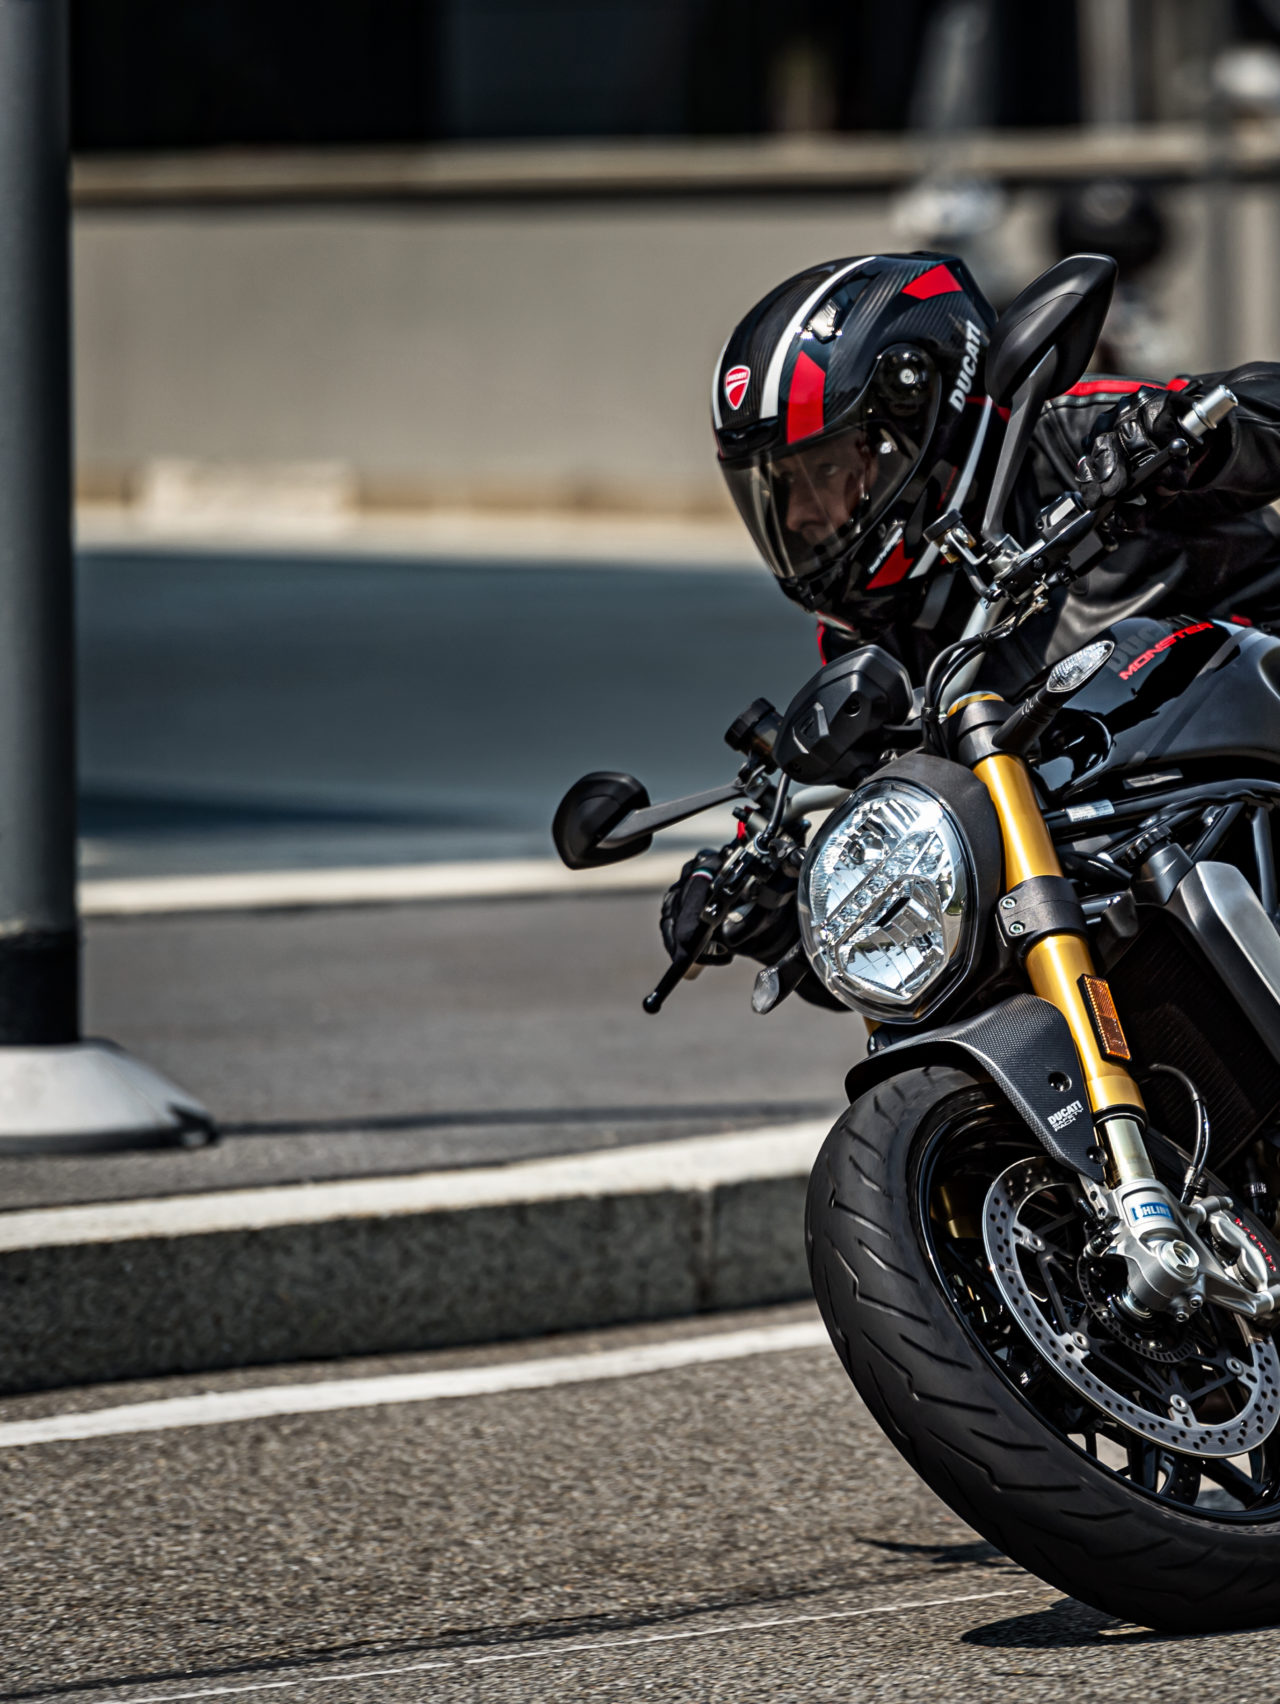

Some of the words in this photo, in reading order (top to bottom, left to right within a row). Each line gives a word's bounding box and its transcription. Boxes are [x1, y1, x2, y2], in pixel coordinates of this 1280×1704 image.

[949, 319, 982, 413] DUCATI
[1118, 622, 1214, 681] MONSTER
[1047, 1100, 1082, 1126] DUCATI
